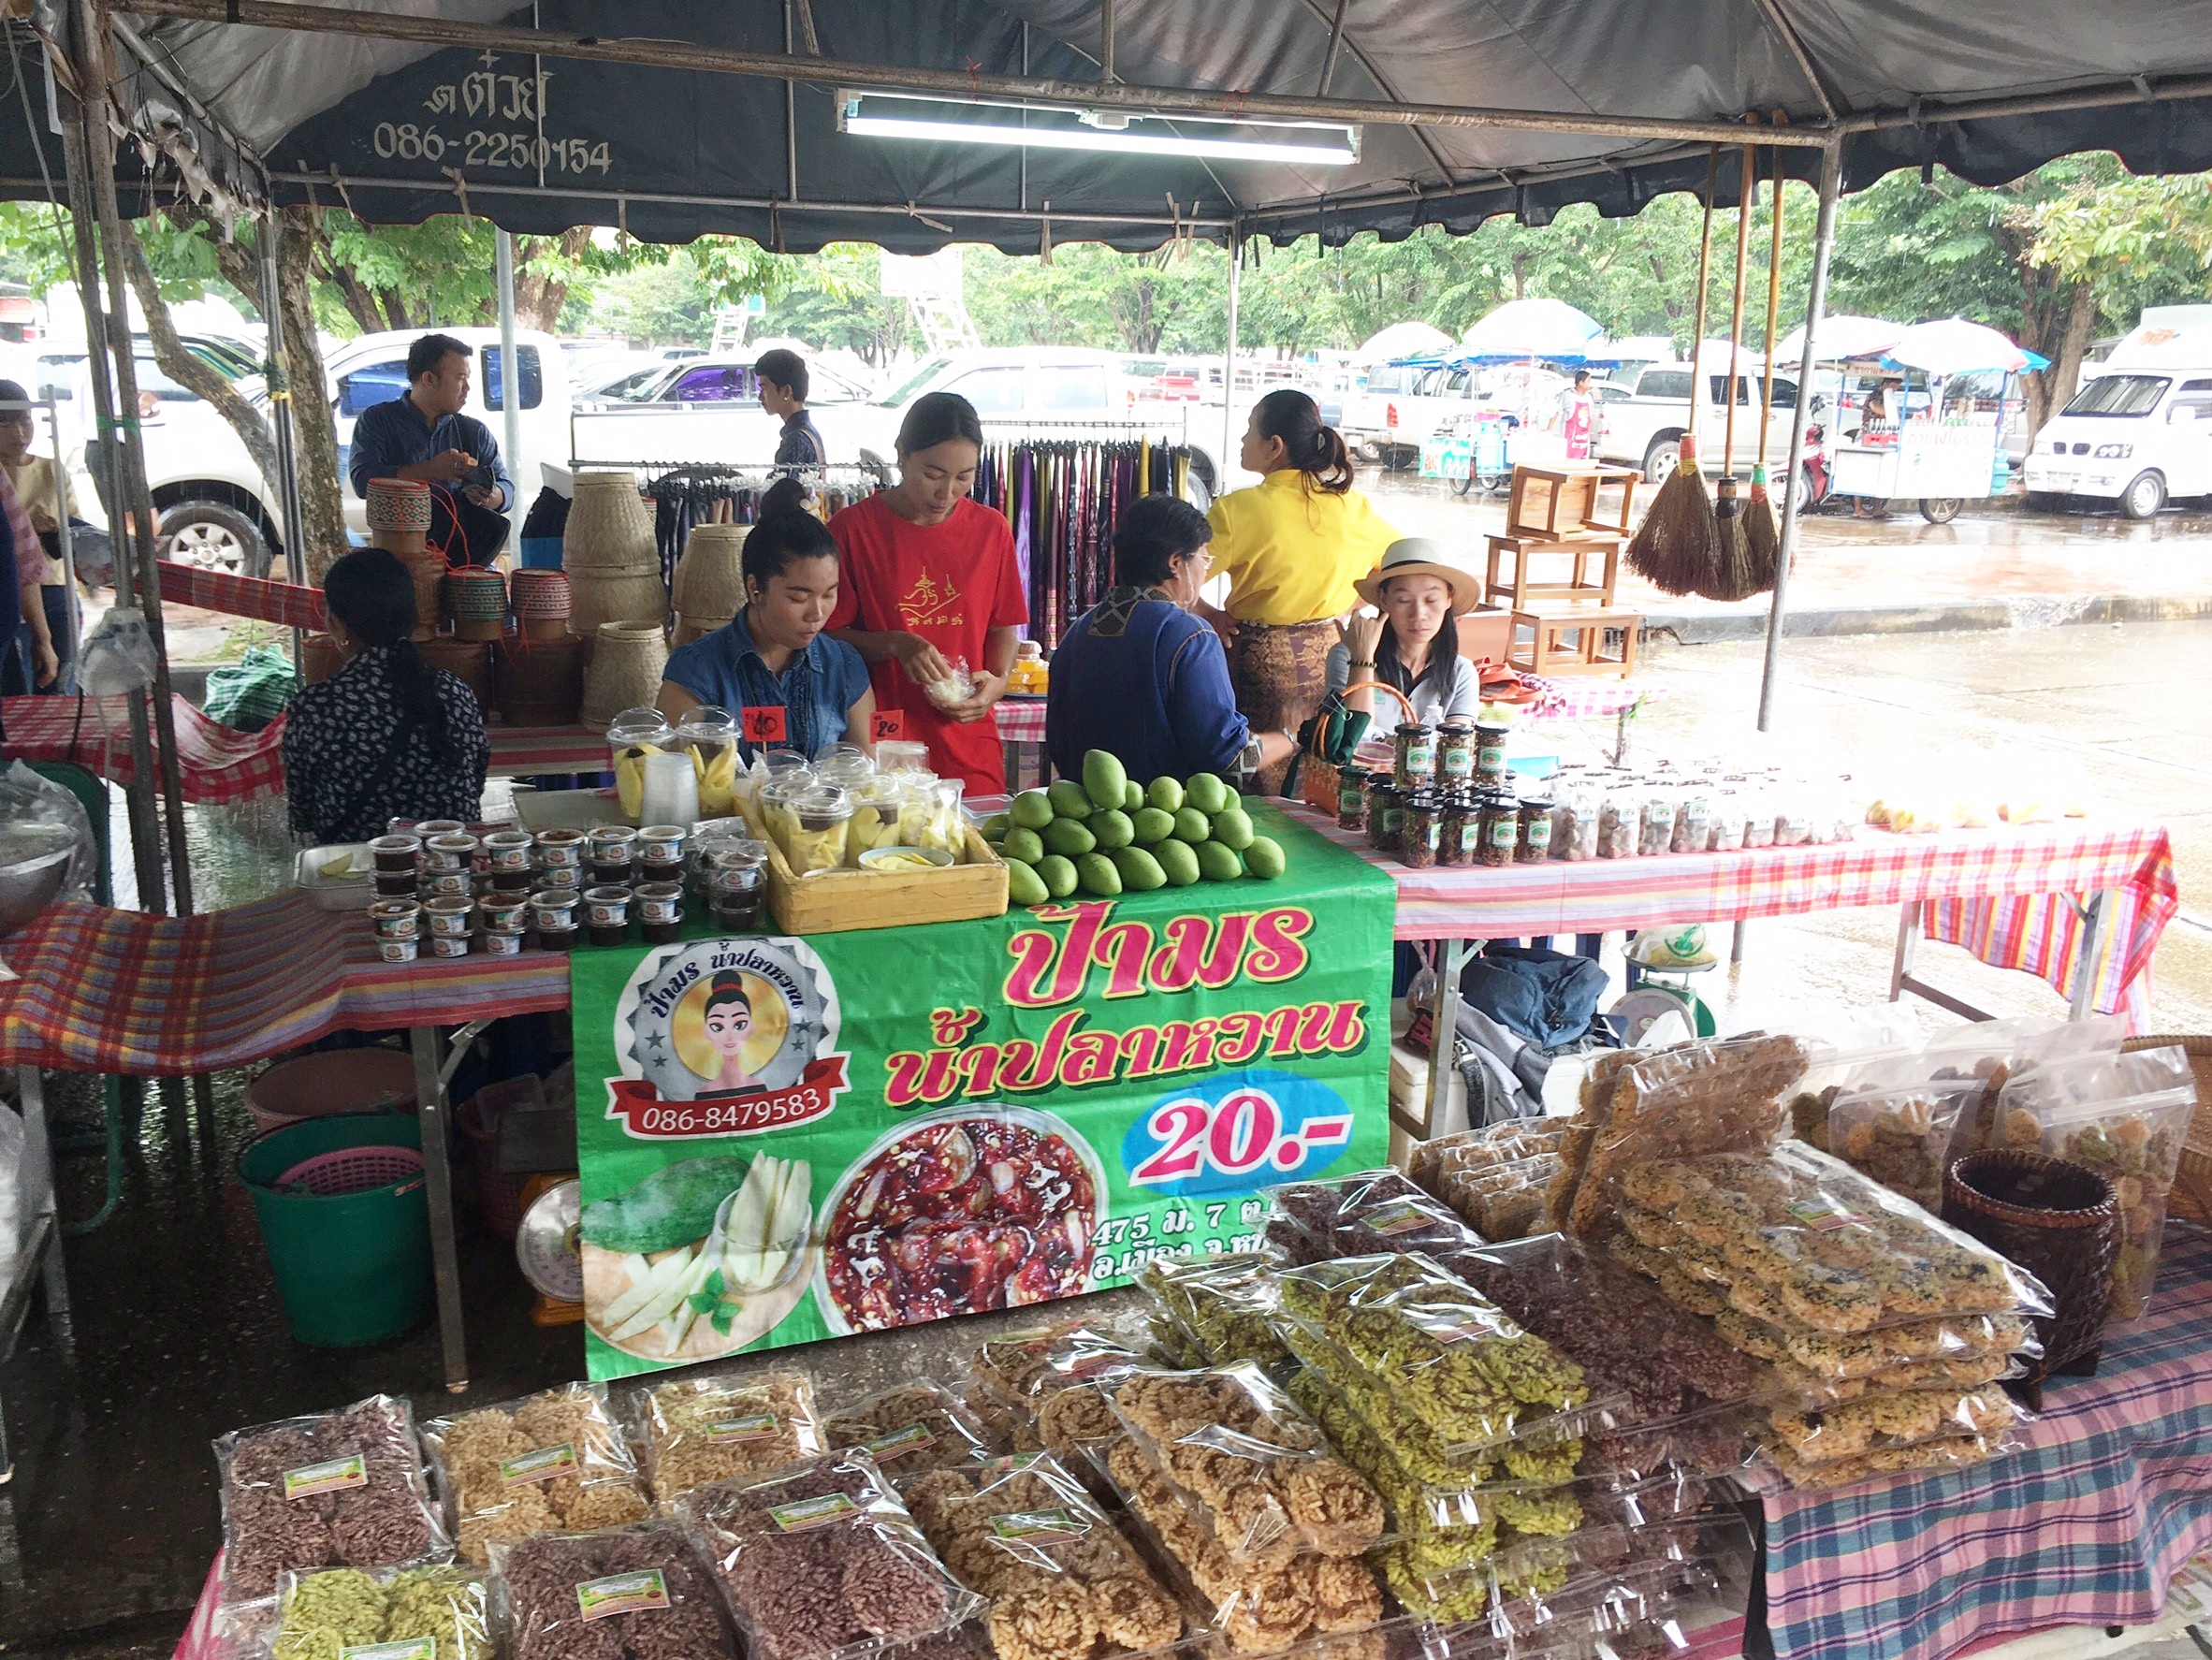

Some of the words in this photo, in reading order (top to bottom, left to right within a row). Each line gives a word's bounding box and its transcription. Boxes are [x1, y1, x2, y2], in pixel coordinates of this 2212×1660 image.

[374, 122, 613, 176] 086-2250154
[644, 962, 700, 1018] ป้ามร
[710, 942, 805, 1009] น้ำปลาหวาน
[1002, 901, 1314, 1009] ป้ามร
[883, 1000, 1369, 1111] น้ำปลาหวาน
[641, 1087, 822, 1131] 086-8479583
[1128, 1086, 1355, 1187] 20.-
[1093, 1214, 1150, 1245] 475
[1161, 1207, 1195, 1235] ม.
[1206, 1203, 1227, 1228] 7
